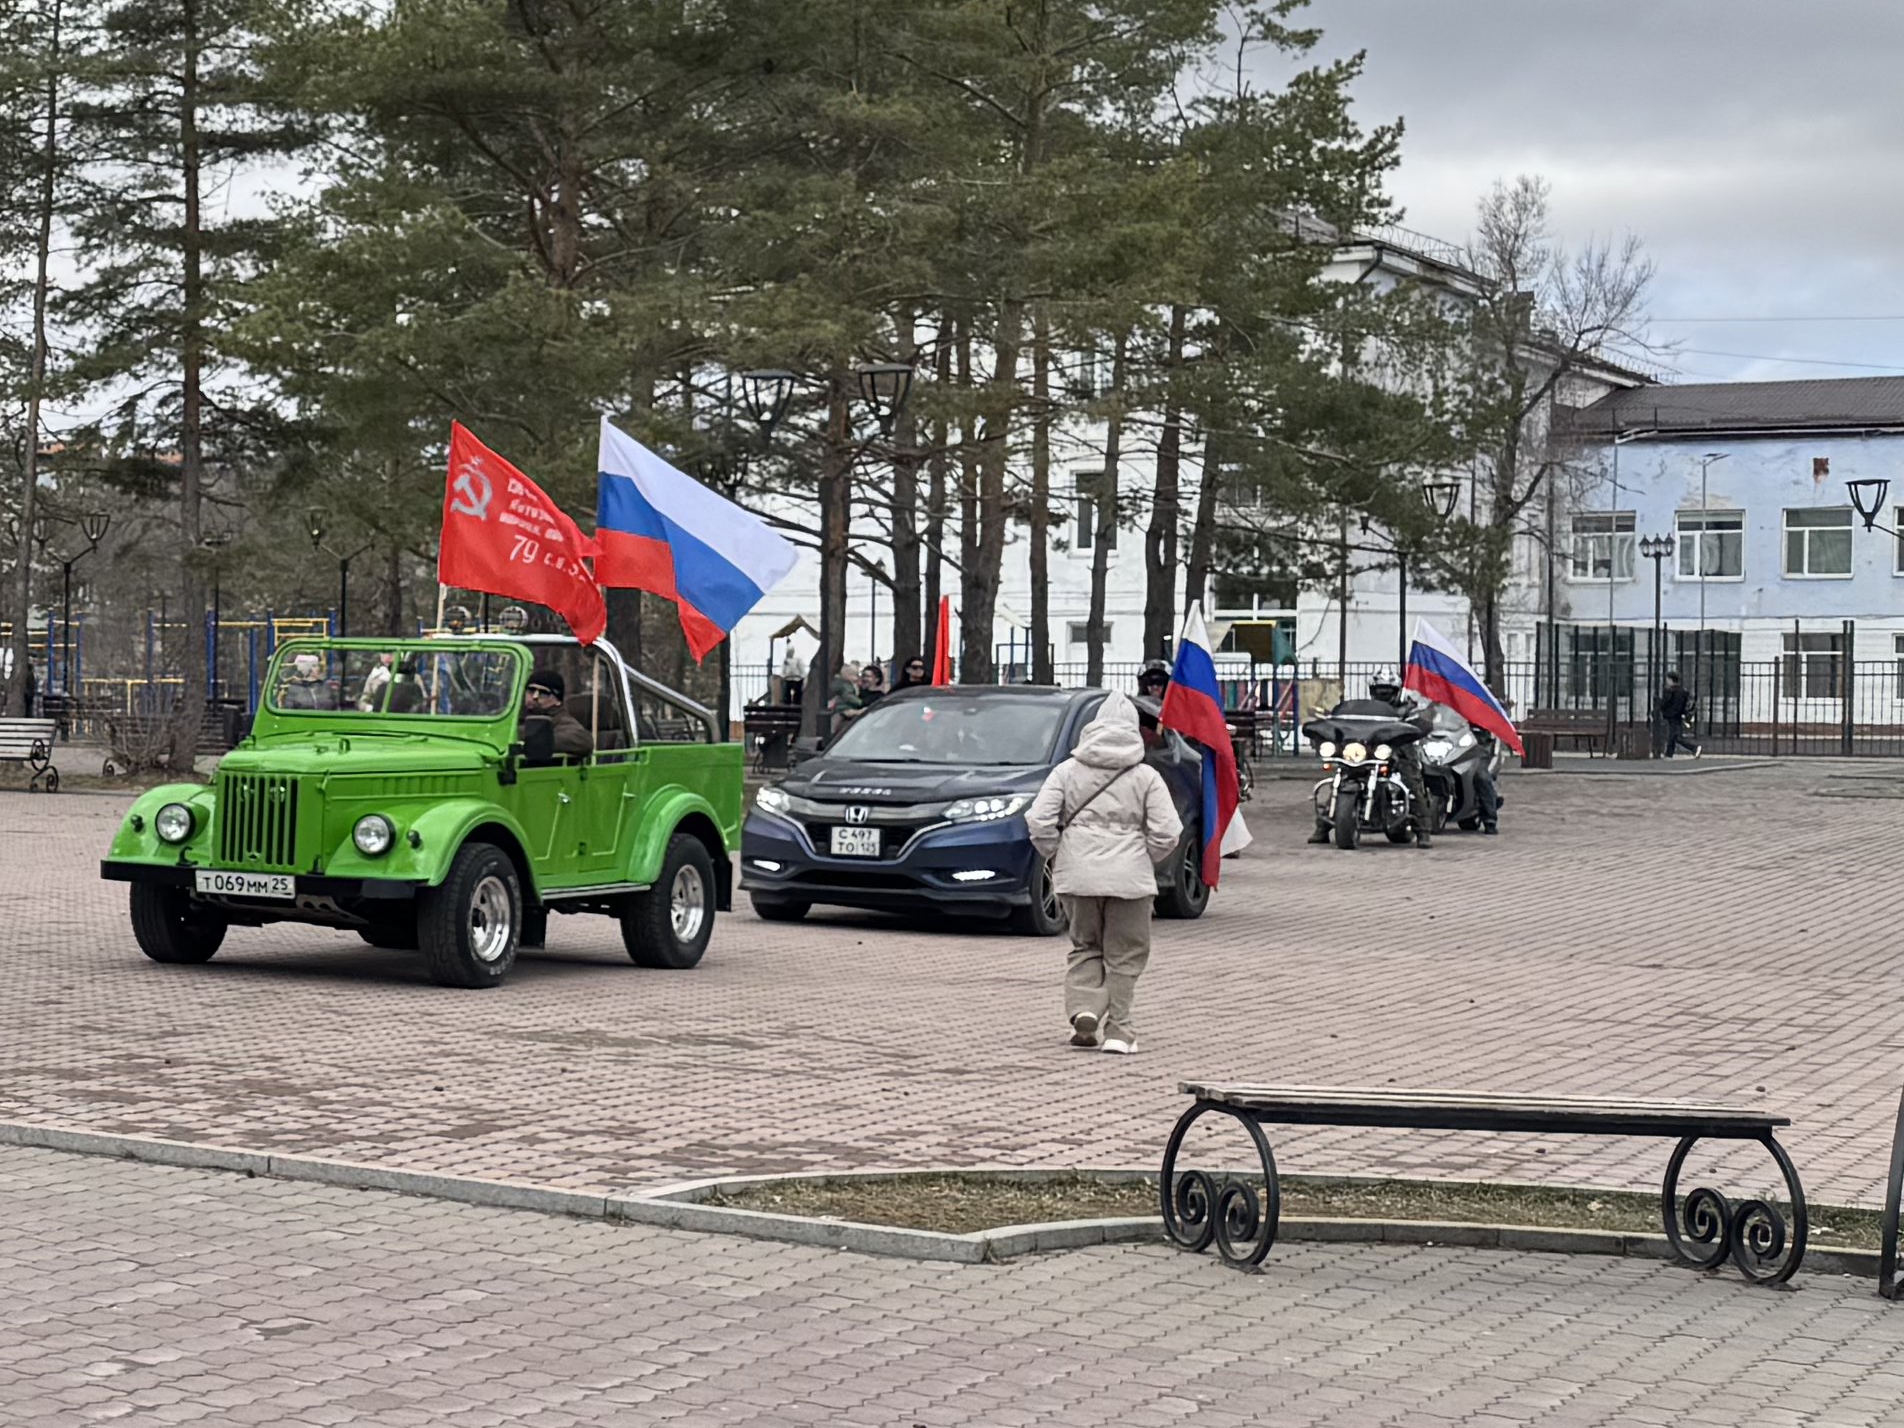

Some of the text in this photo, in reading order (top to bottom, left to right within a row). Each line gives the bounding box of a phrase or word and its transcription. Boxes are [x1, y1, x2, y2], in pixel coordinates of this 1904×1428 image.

[510, 535, 539, 563] 79
[203, 875, 288, 893] Т069ММ 25
